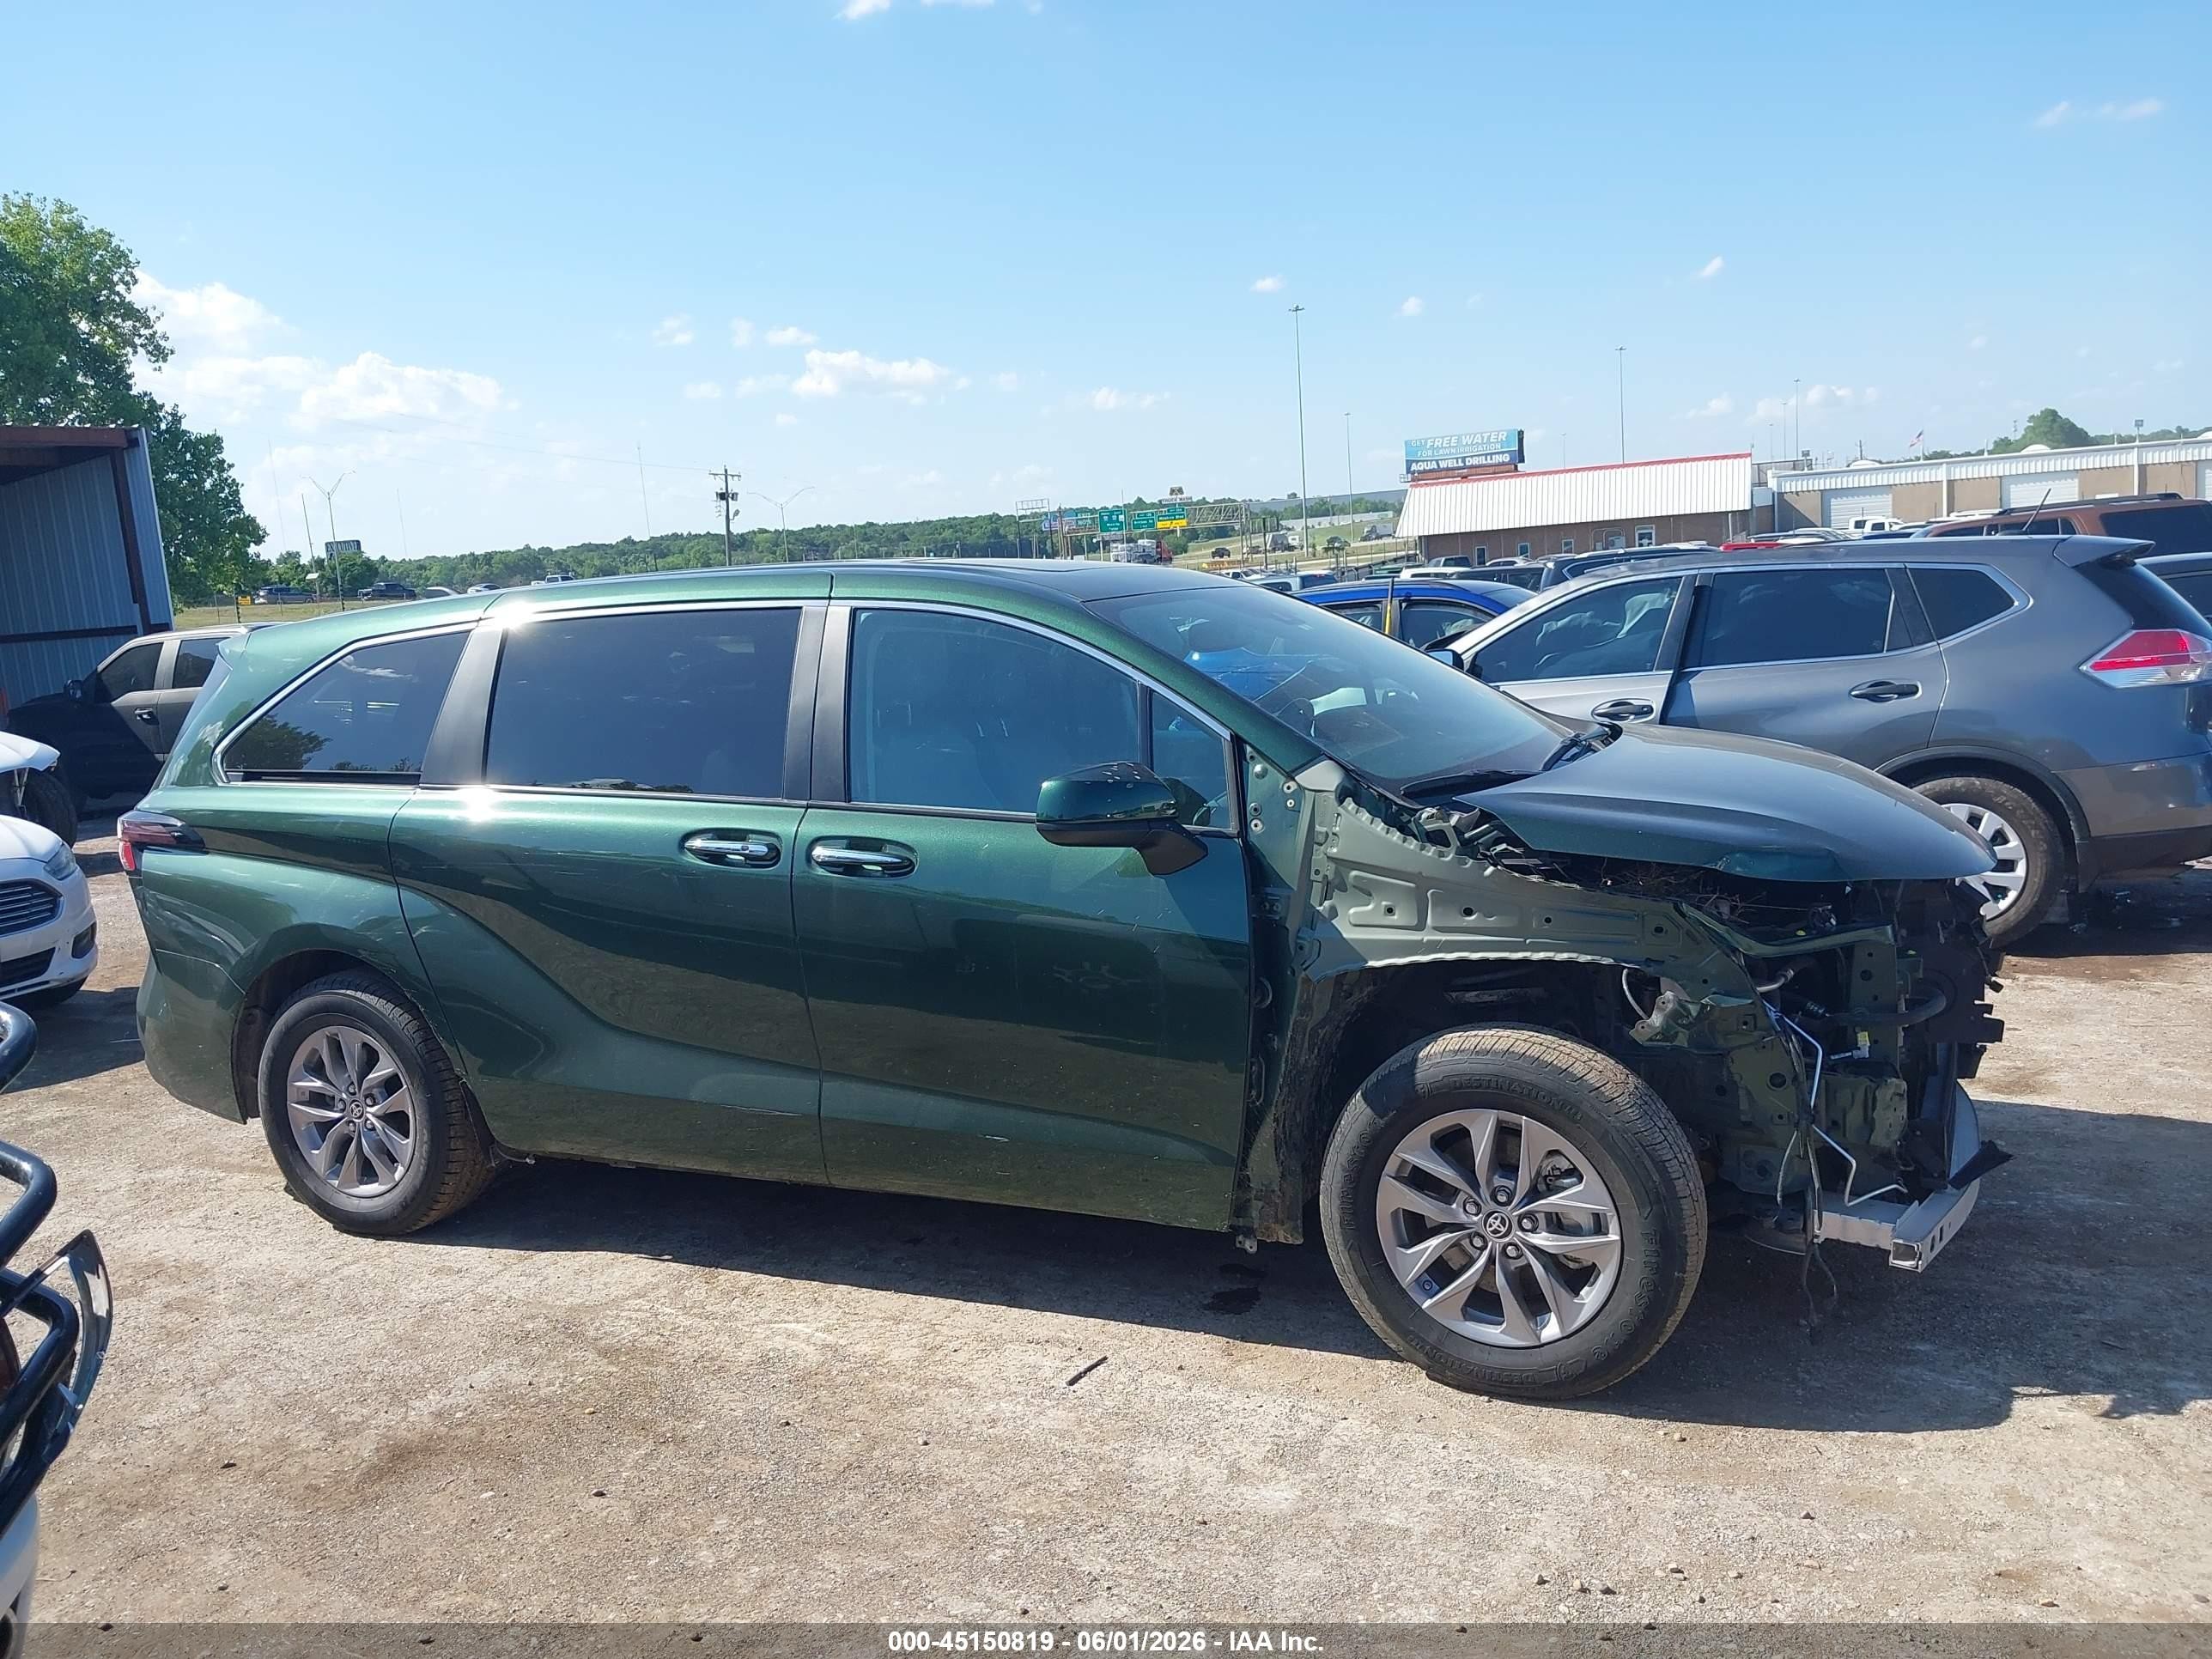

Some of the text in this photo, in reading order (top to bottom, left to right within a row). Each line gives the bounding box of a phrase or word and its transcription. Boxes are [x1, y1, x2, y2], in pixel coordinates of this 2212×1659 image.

[1426, 435, 1458, 448] FREE
[1462, 431, 1508, 446] WATER
[1434, 447, 1456, 456] LAWN
[1457, 443, 1501, 454] IRRIGATION
[1410, 453, 1510, 471] AQUA WELL DRILLING
[1449, 1077, 1564, 1110] DESTINATION
